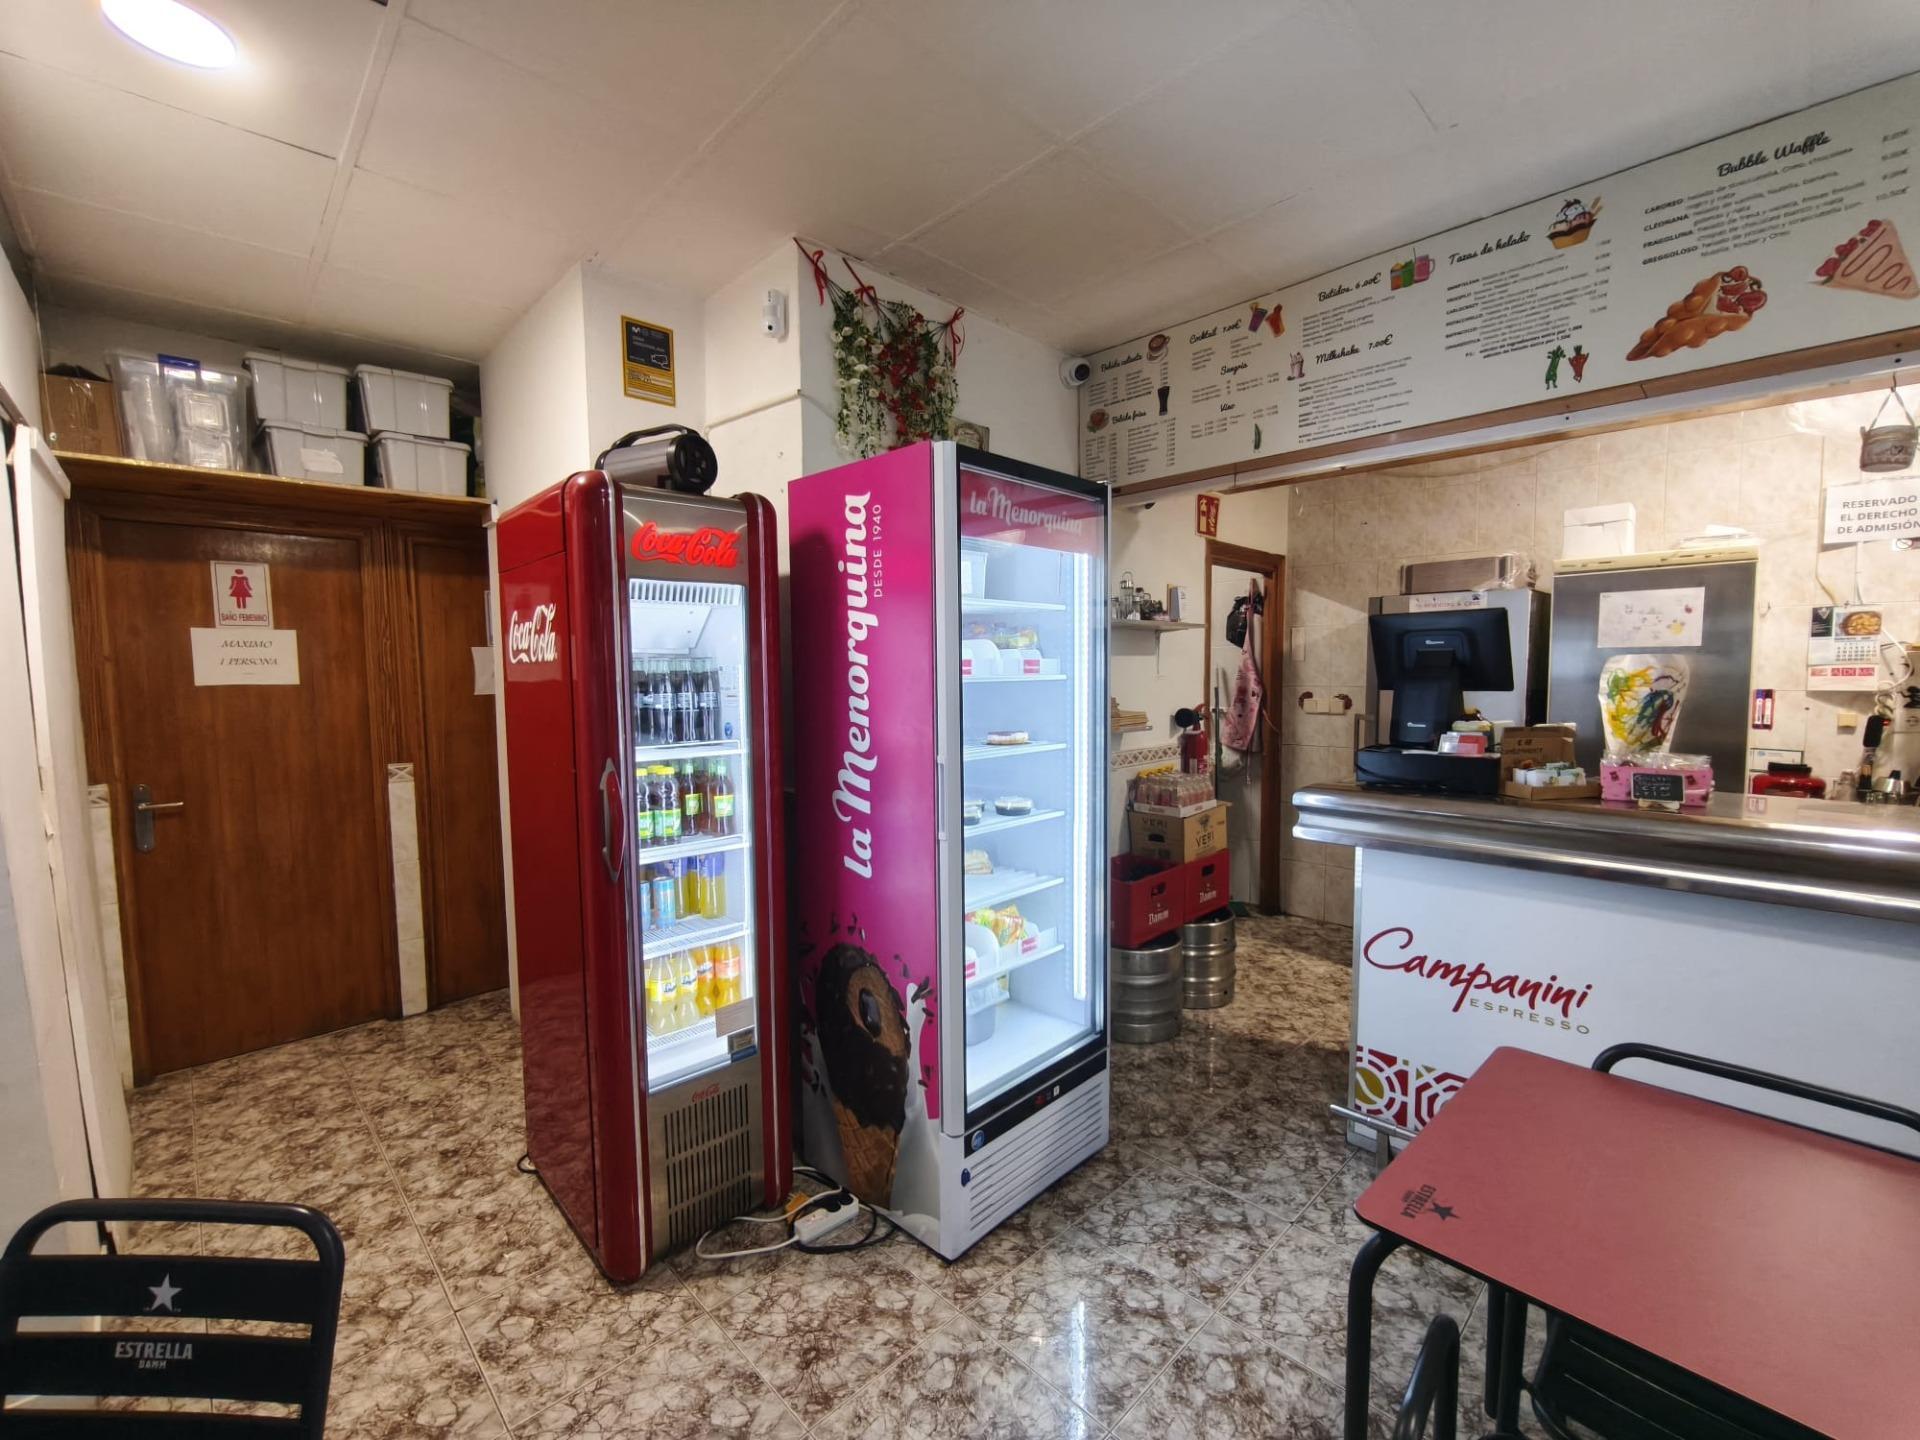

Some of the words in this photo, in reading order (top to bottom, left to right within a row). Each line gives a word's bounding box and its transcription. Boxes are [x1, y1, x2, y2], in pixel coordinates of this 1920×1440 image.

[1717, 152, 1768, 177] Bubble
[1774, 130, 1832, 161] Waffle
[1448, 250, 1478, 265] Tazas
[1480, 243, 1494, 255] de
[1496, 231, 1531, 250] helado
[1189, 326, 1218, 344] Cocktail
[1315, 343, 1360, 364] Milkshake
[970, 491, 988, 516] la
[988, 486, 1082, 536] Menorquina
[1840, 513, 1854, 522] EL
[1857, 507, 1918, 522] DERECHO
[1842, 494, 1918, 509] RESERVADO
[872, 503, 883, 541] 1940
[1837, 526, 1853, 535] DE
[1855, 520, 1920, 534] ADMISIÓN
[873, 548, 883, 598] DESDE
[228, 657, 278, 666] PERSONA
[832, 490, 879, 824] Menorquina
[844, 828, 873, 880] la
[1363, 926, 1593, 1018] Campanini
[1469, 997, 1591, 1035] ESPRESSO
[115, 1341, 193, 1360] ESTRELLA
[138, 1360, 167, 1369] DAMM
